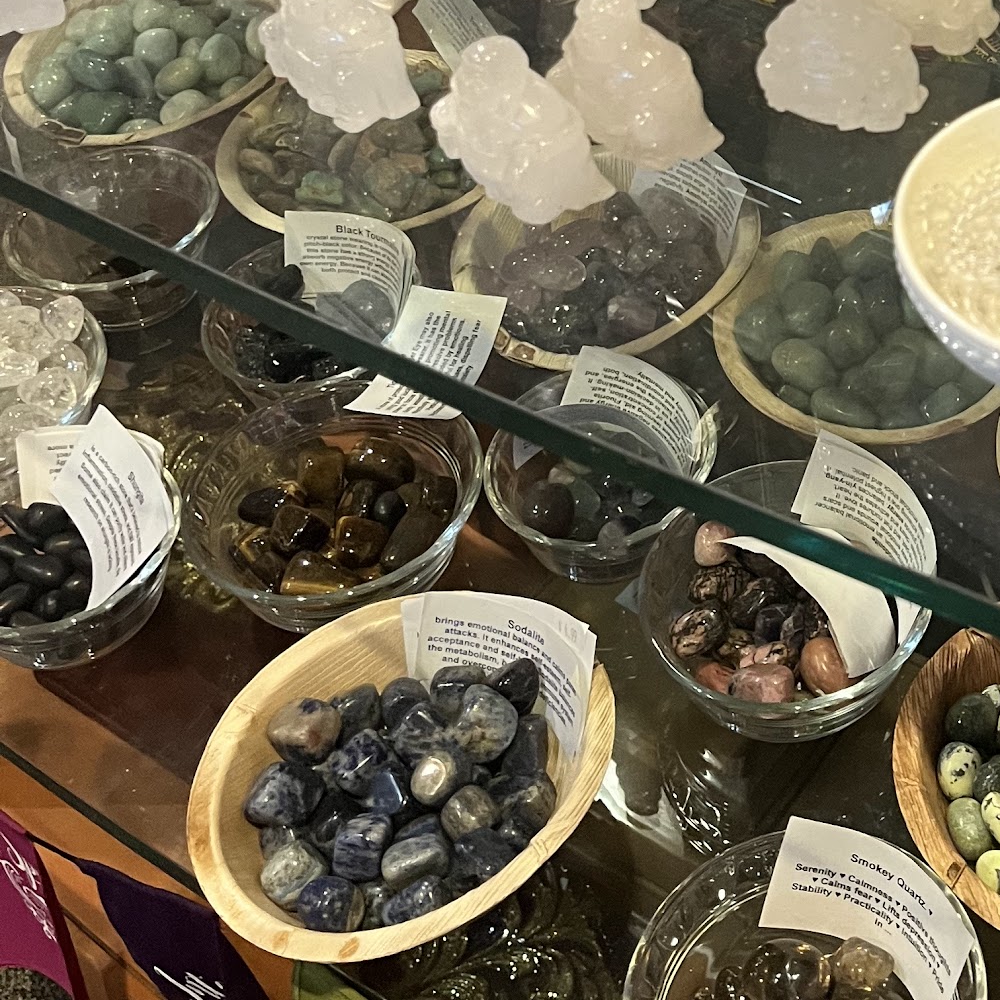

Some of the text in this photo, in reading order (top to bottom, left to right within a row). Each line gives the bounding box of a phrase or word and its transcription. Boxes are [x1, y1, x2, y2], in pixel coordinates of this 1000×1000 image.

[335, 225, 363, 236] Black
[472, 319, 481, 333] fear
[427, 635, 499, 654] acceptance and
[435, 616, 541, 654] brings emotional balance
[444, 628, 480, 639] attacks.
[491, 637, 529, 657] enhances
[507, 619, 545, 646] Sodalite
[427, 644, 500, 665] the metabolism,
[441, 655, 460, 664] and
[850, 853, 927, 911] Smokey Quartz
[791, 882, 833, 898] Stability
[843, 893, 894, 925] Practicality
[795, 863, 929, 938] Serenity Calmness Positive
[820, 877, 852, 892] Calms
[854, 887, 873, 901] fear
[882, 901, 900, 920] Lifts
[901, 918, 936, 962] depression
